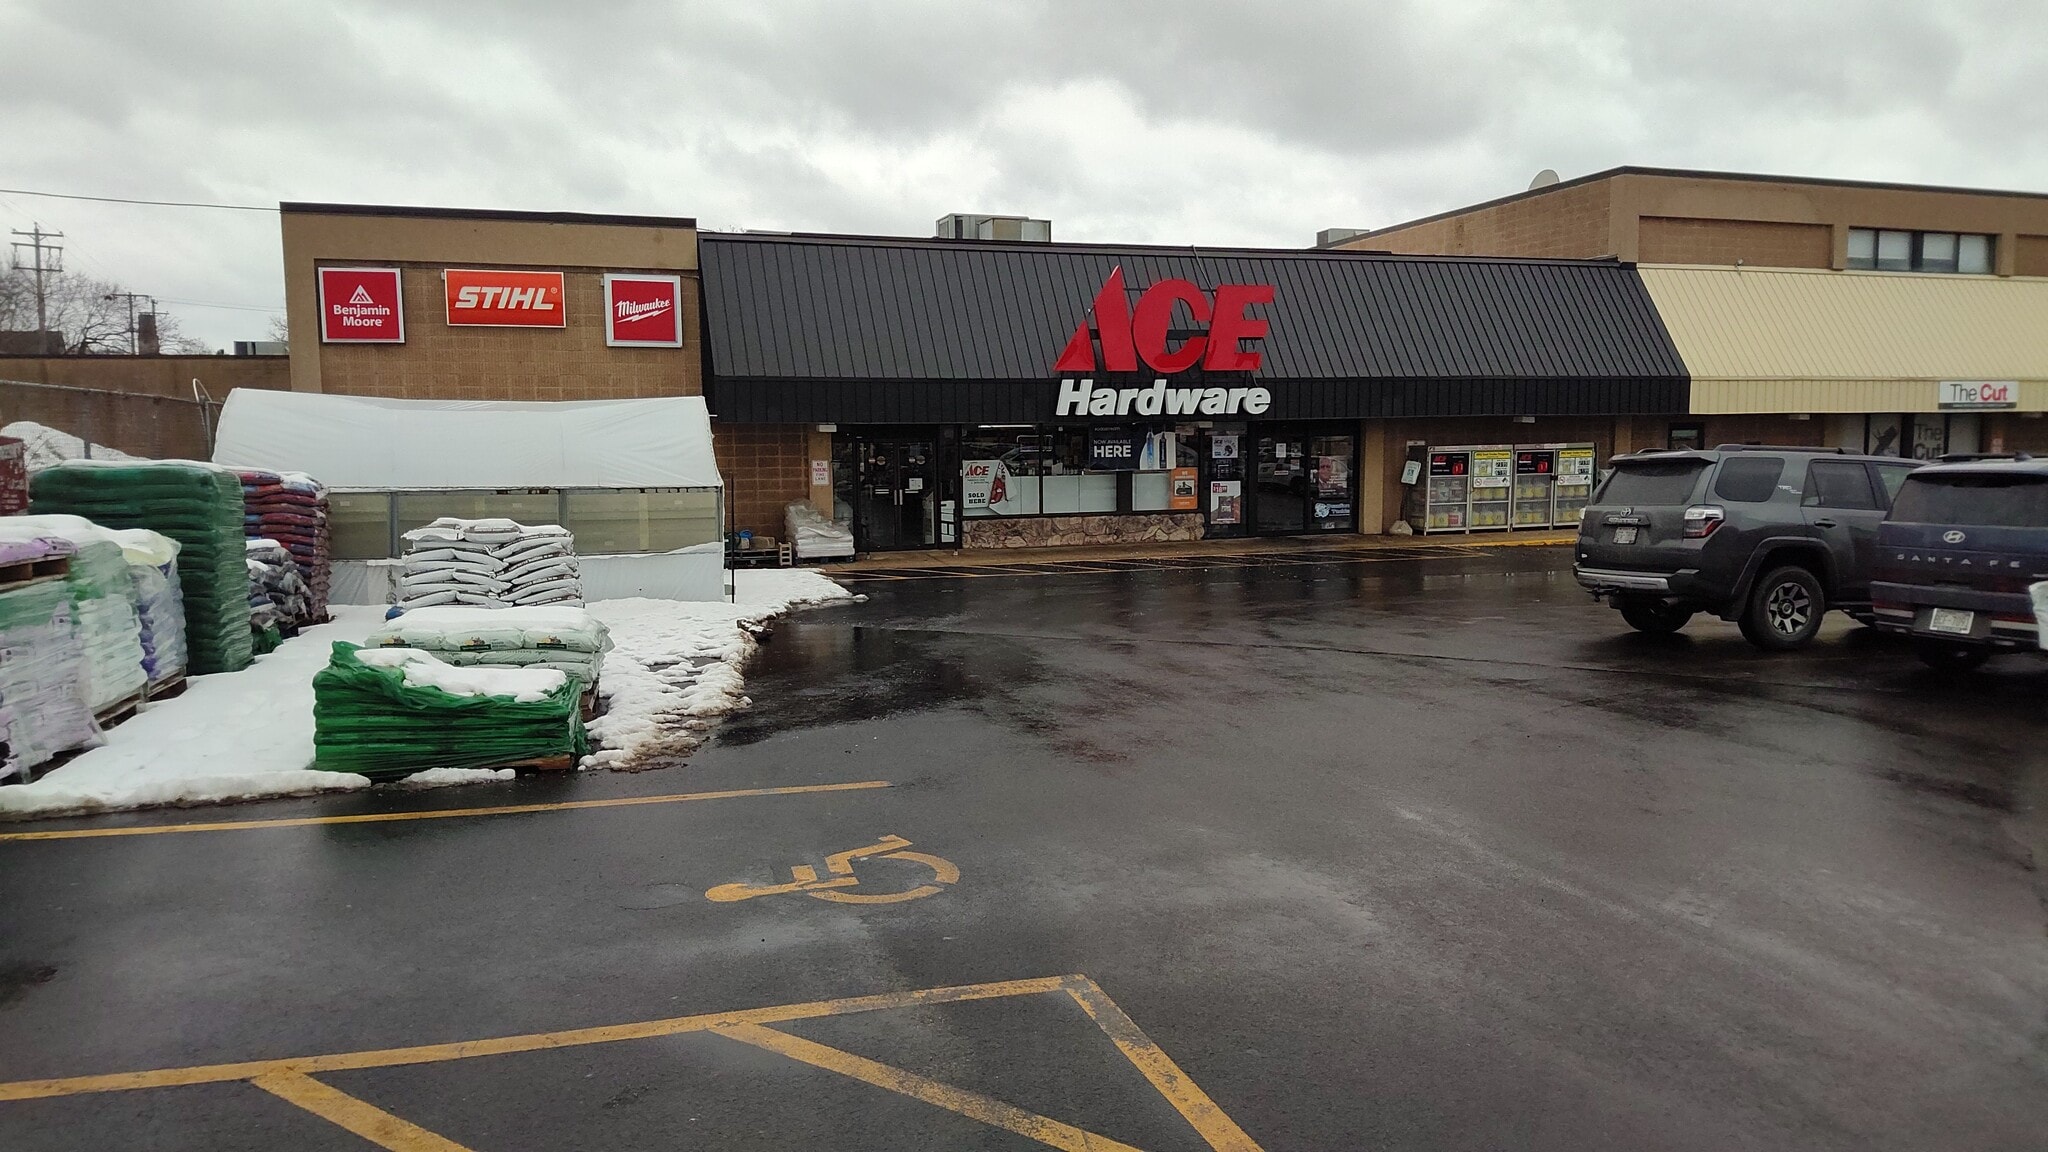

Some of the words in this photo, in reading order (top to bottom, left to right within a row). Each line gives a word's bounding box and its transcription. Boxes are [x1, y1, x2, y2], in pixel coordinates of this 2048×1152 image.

[454, 286, 555, 311] STIHL
[614, 297, 671, 318] Milwaukee
[333, 304, 391, 318] Benjamin
[1053, 265, 1276, 374] ACE
[342, 316, 383, 327] Moore
[1055, 379, 1271, 416] Hardware
[1950, 383, 1978, 402] The
[1980, 383, 2008, 402] Cut
[1913, 423, 1942, 442] The
[1093, 445, 1132, 458] HERE
[1914, 443, 1943, 460] Cut
[965, 464, 990, 477] ACE
[1896, 554, 1973, 566] SANTA
[1989, 560, 2021, 569] FE
